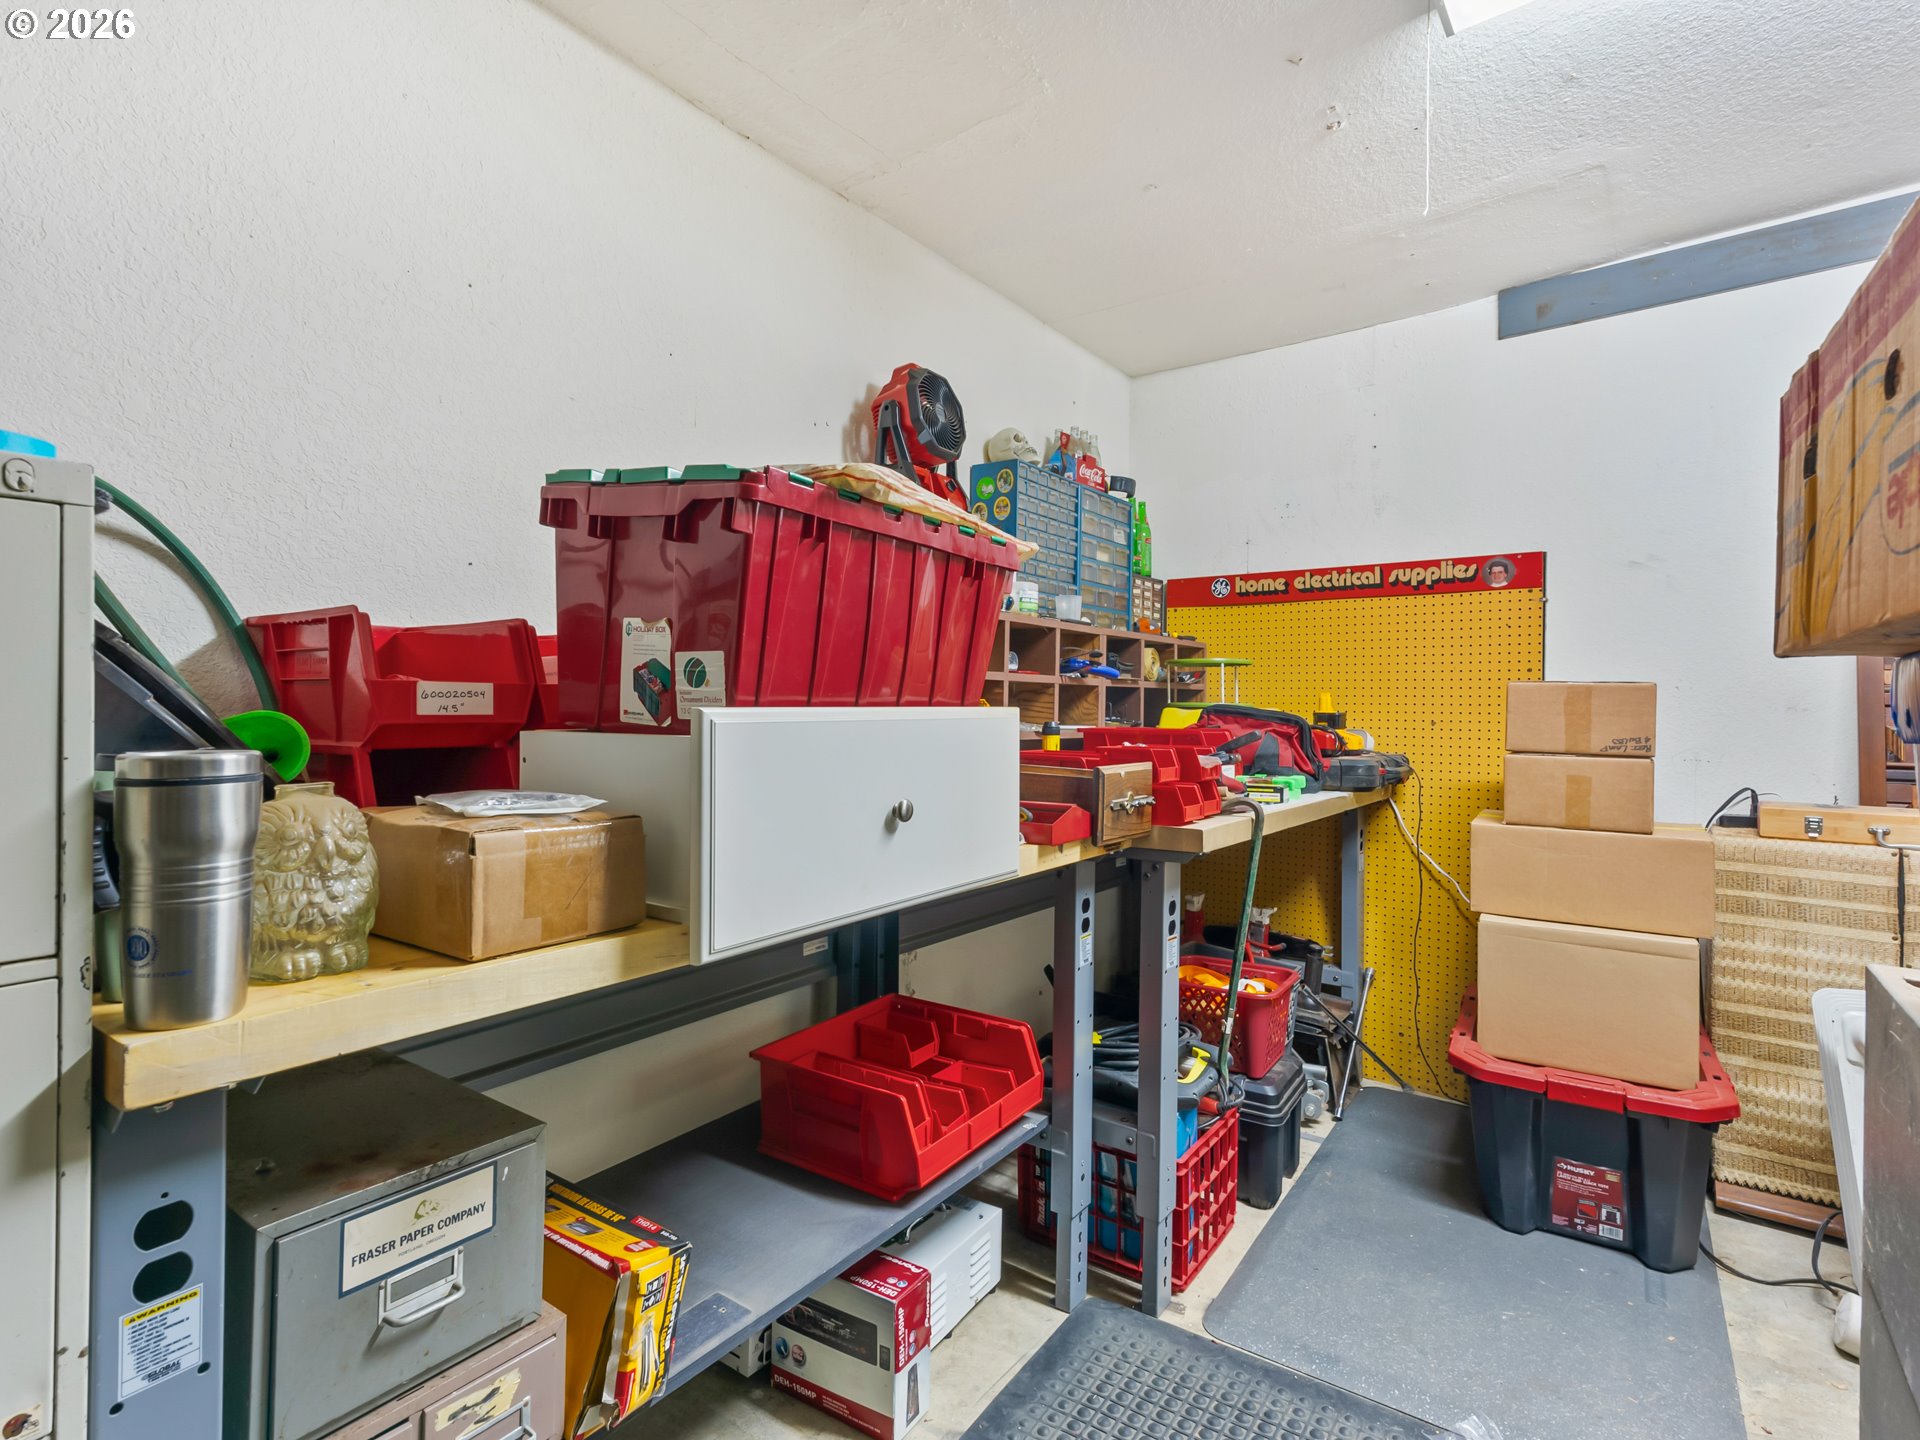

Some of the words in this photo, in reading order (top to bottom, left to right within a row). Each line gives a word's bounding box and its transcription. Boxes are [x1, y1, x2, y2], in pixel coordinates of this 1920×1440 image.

[1235, 576, 1287, 594] home
[1293, 565, 1382, 591] electrical
[1388, 560, 1478, 588] supplies
[421, 690, 486, 700] 600020504
[351, 1239, 397, 1268] FRASER
[399, 1223, 435, 1247] PAPER
[437, 1201, 487, 1230] COMPANY
[634, 1216, 658, 1231] THD14
[880, 1254, 924, 1273] Pioneer
[137, 1291, 198, 1320] WARNING
[774, 1374, 817, 1400] DEH-150MP
